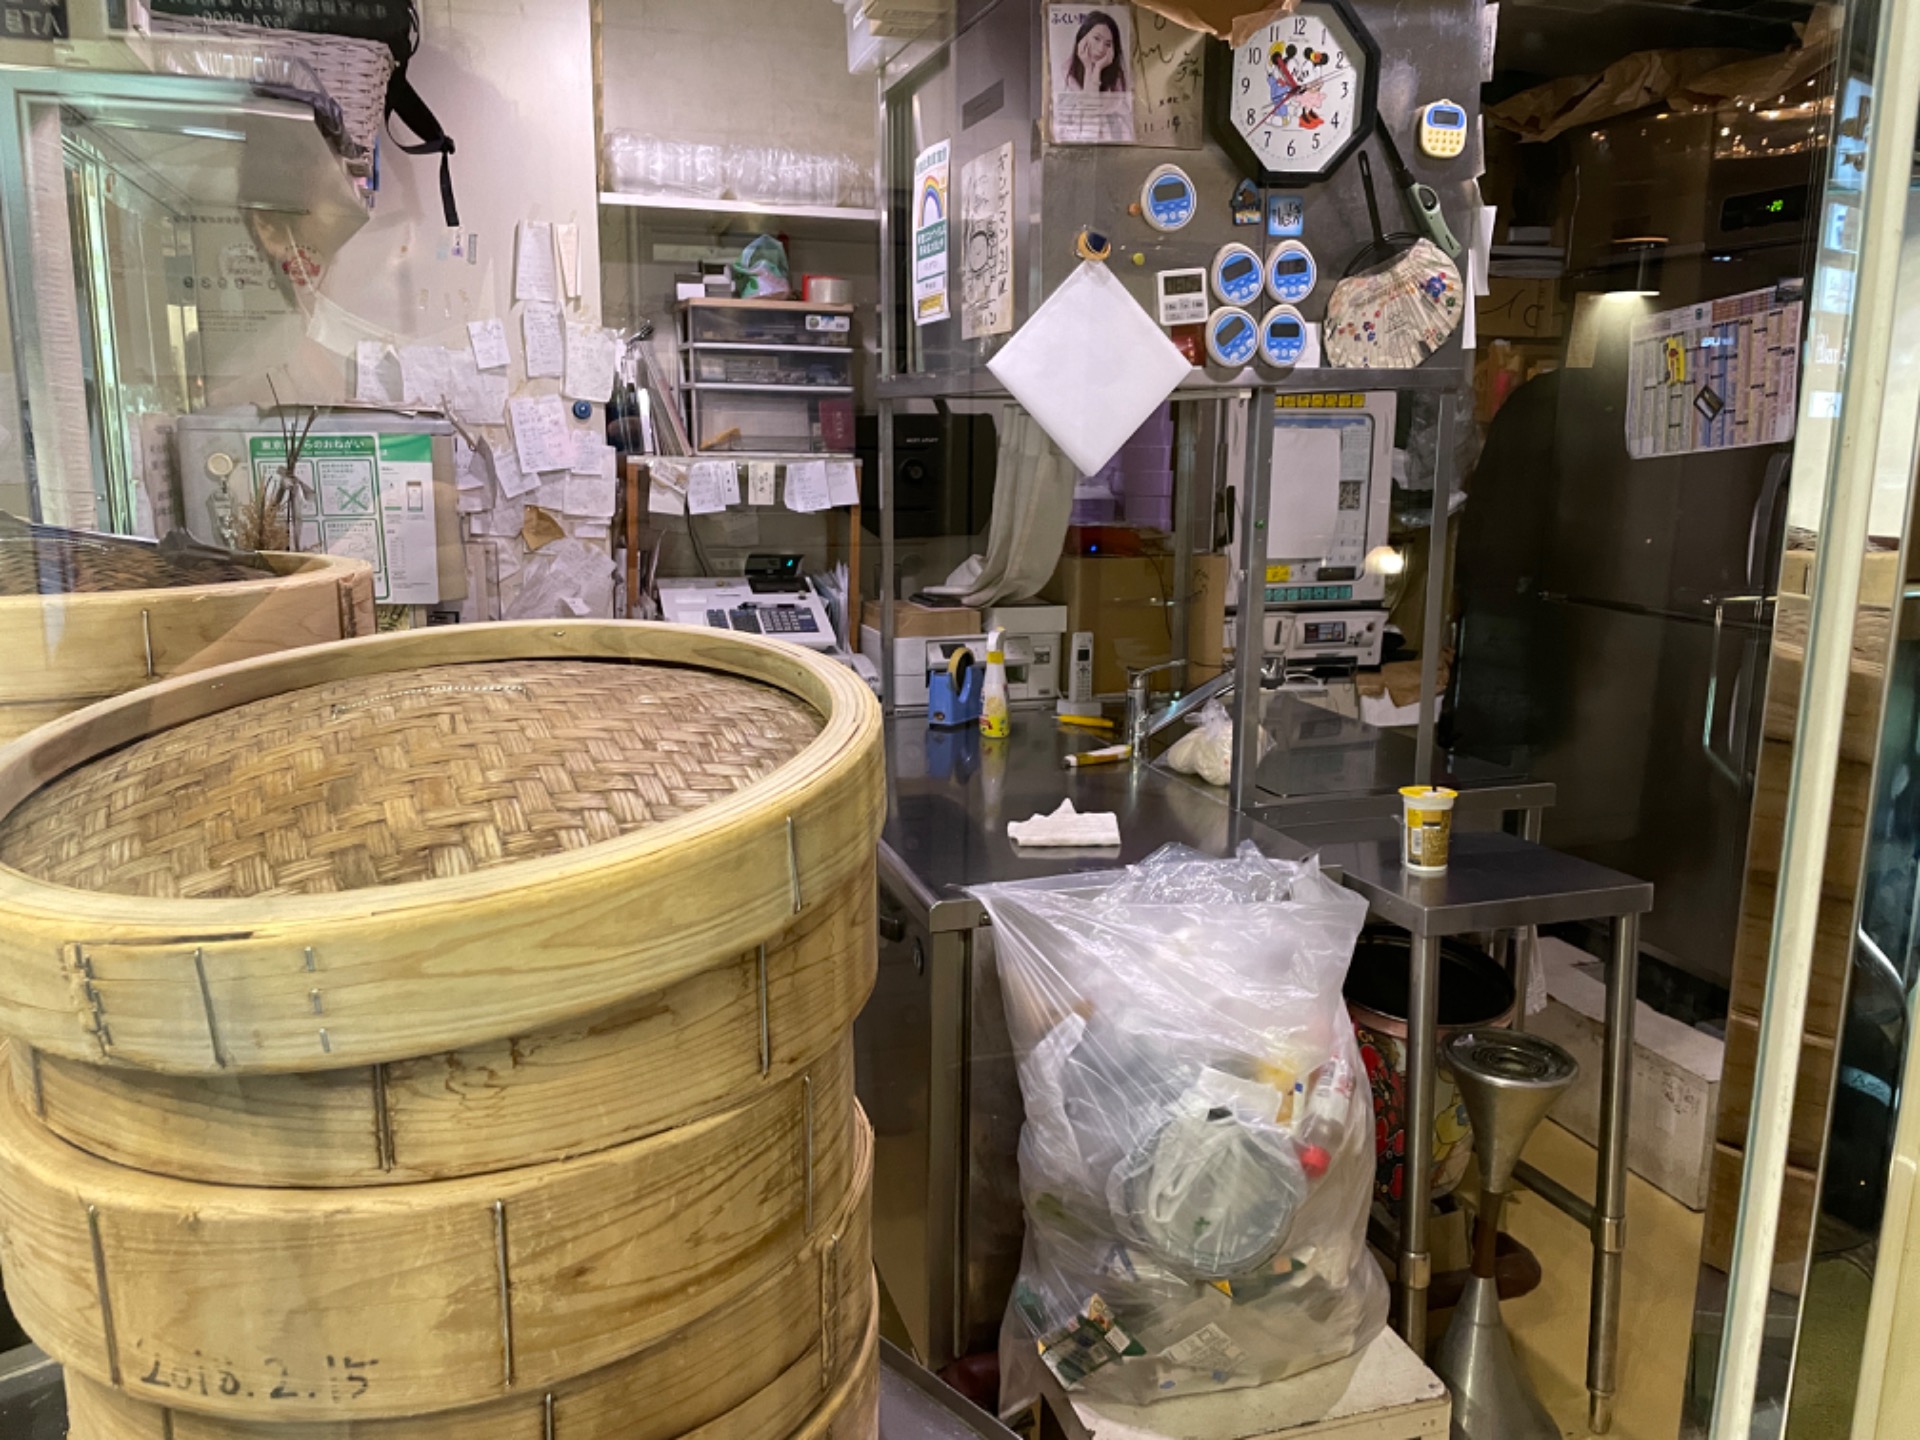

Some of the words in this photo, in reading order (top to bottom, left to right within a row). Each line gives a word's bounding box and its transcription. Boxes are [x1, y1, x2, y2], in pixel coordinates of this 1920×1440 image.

[1269, 25, 1279, 43] 11
[1293, 17, 1307, 35] 12
[1321, 27, 1327, 46] 1
[1248, 47, 1261, 65] 10
[1335, 51, 1344, 69] 2
[1241, 77, 1250, 95] 9
[1341, 81, 1349, 99] 3
[1247, 108, 1256, 126] 8
[1331, 111, 1340, 129] 4
[1264, 130, 1272, 148] 7
[1287, 139, 1296, 157] 6
[1312, 132, 1321, 150] 5
[262, 439, 365, 450] 東京らのおねがい
